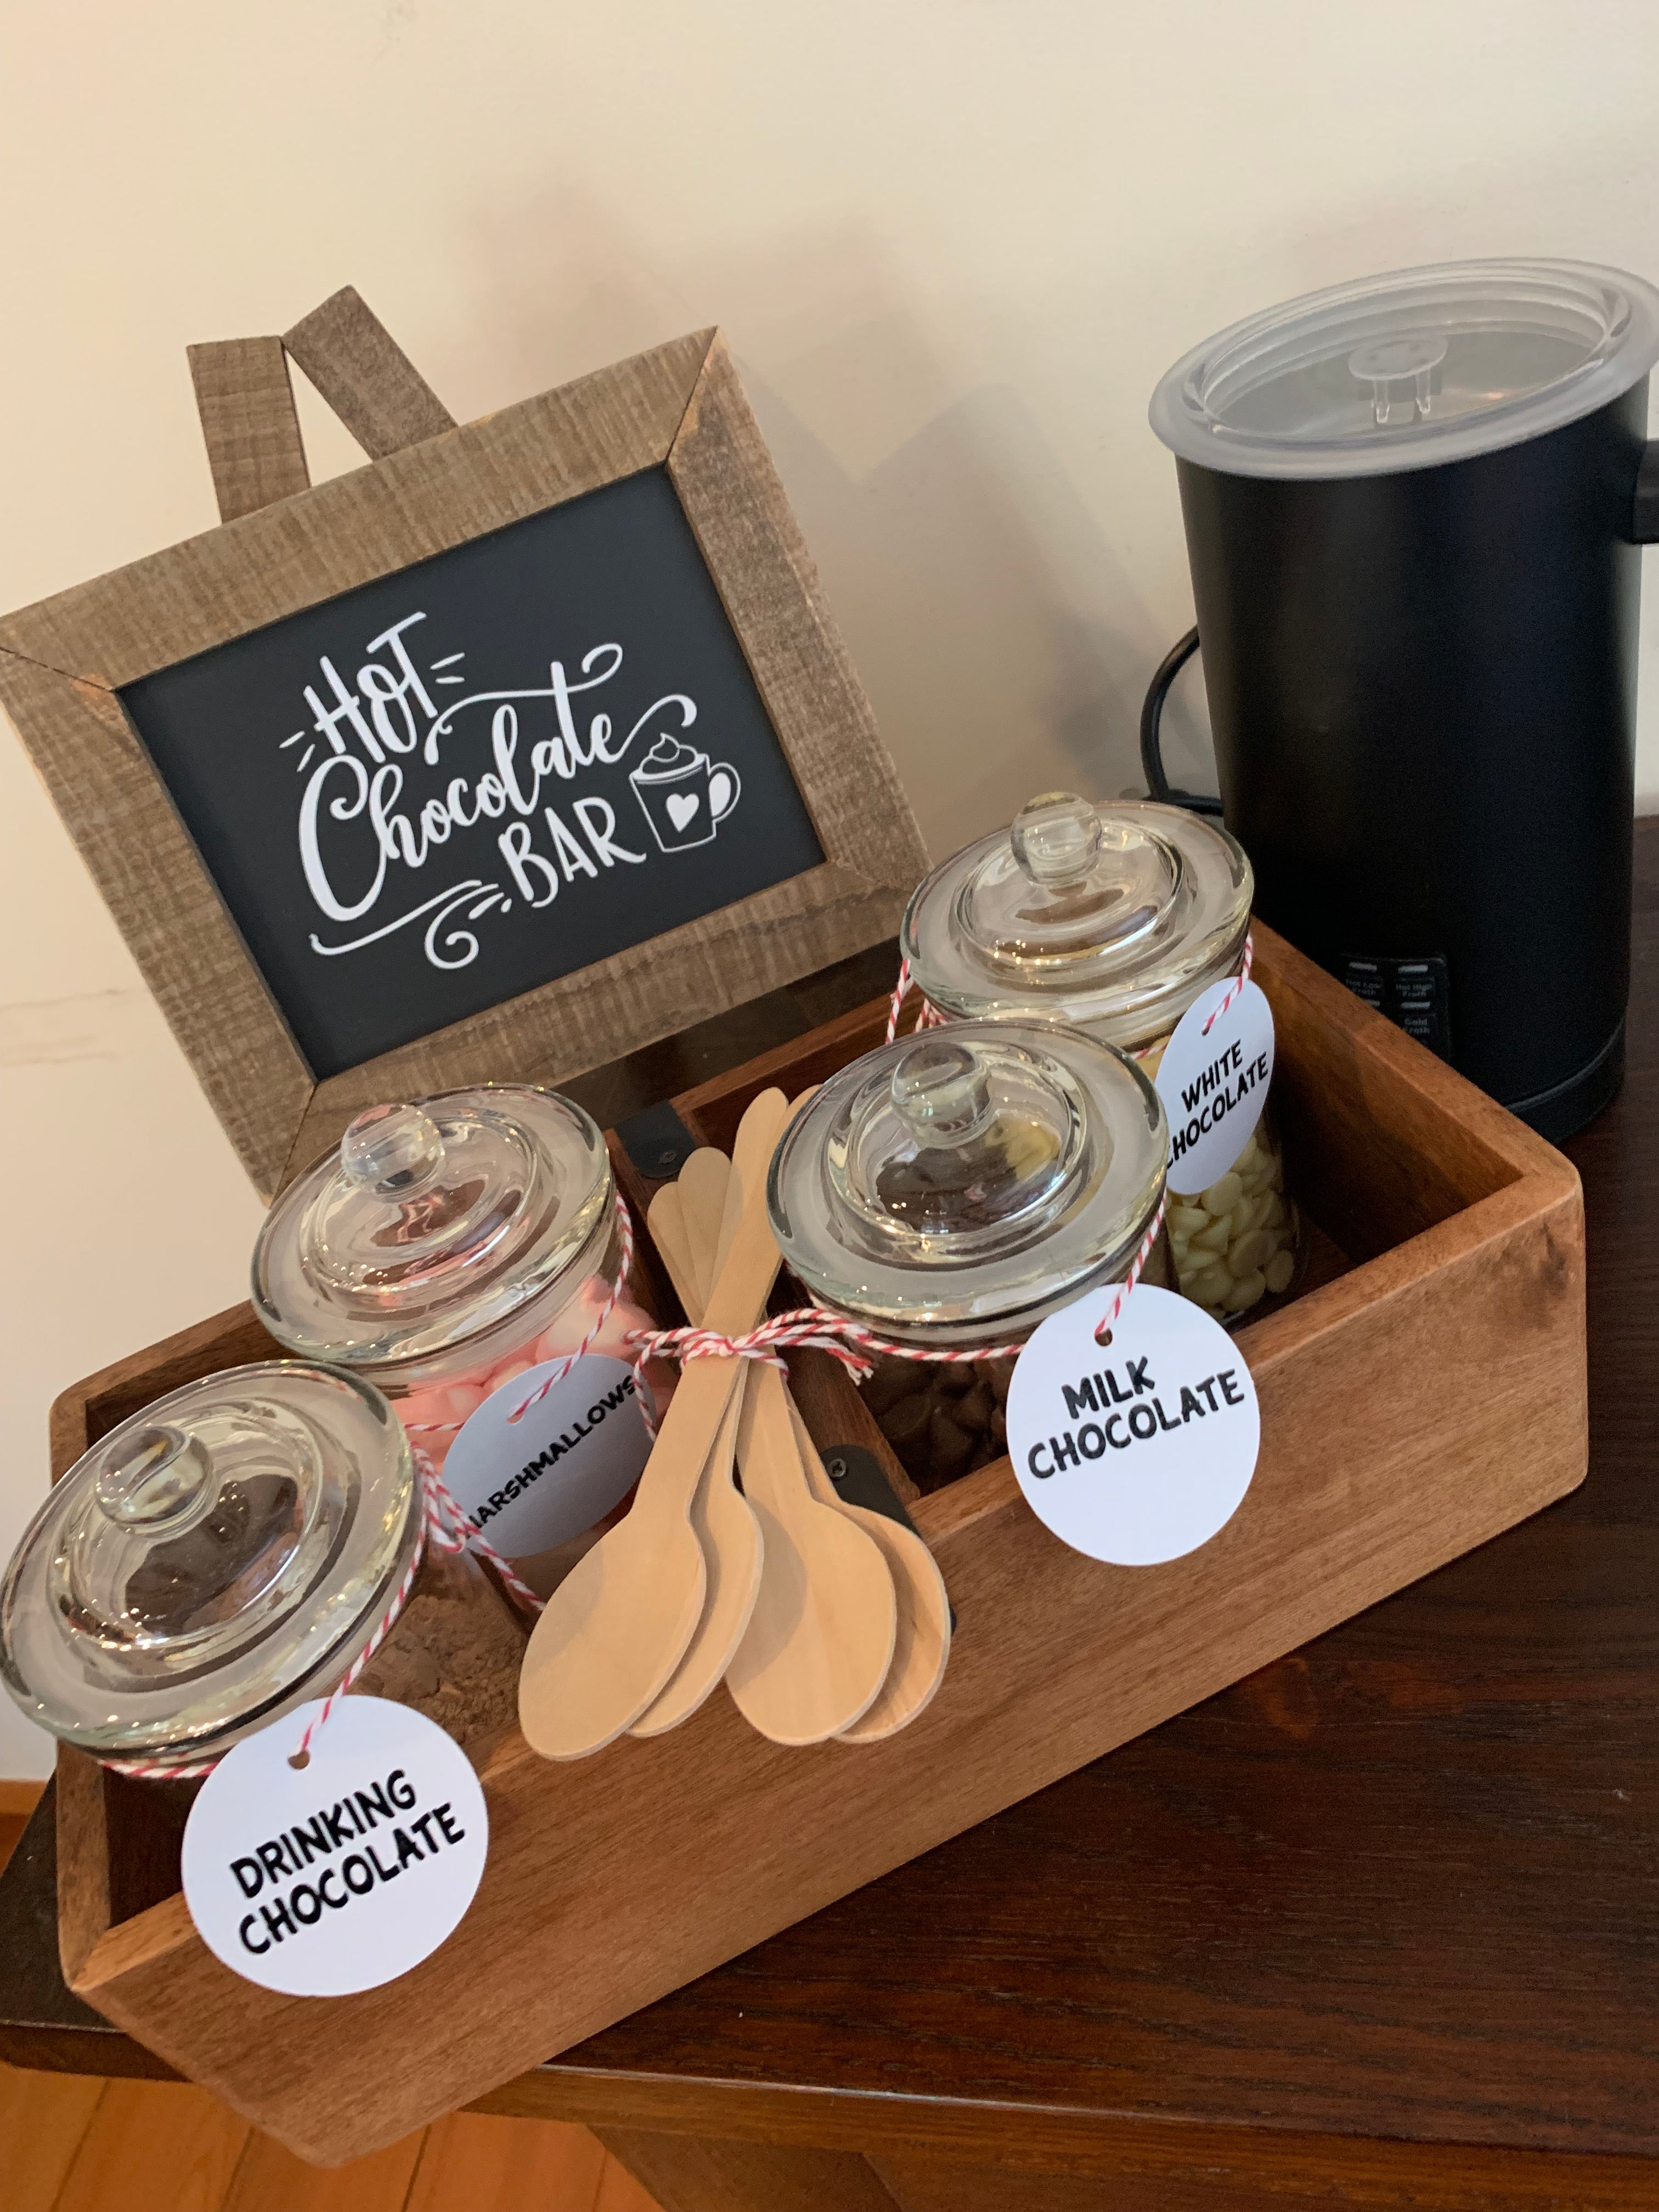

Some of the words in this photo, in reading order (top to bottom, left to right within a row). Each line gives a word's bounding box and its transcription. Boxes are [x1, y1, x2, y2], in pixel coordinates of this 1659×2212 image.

[302, 611, 438, 764] HOT
[299, 643, 697, 922] Chocolate
[498, 796, 647, 908] BAR
[1167, 1051, 1268, 1170] HOCOLATE
[1181, 1039, 1243, 1113] WHITE
[1028, 1368, 1245, 1479] CHOCOLATE
[1061, 1356, 1155, 1419] MILK
[229, 1769, 416, 1899] DRINKING
[238, 1802, 466, 1955] CHOCOLATE
